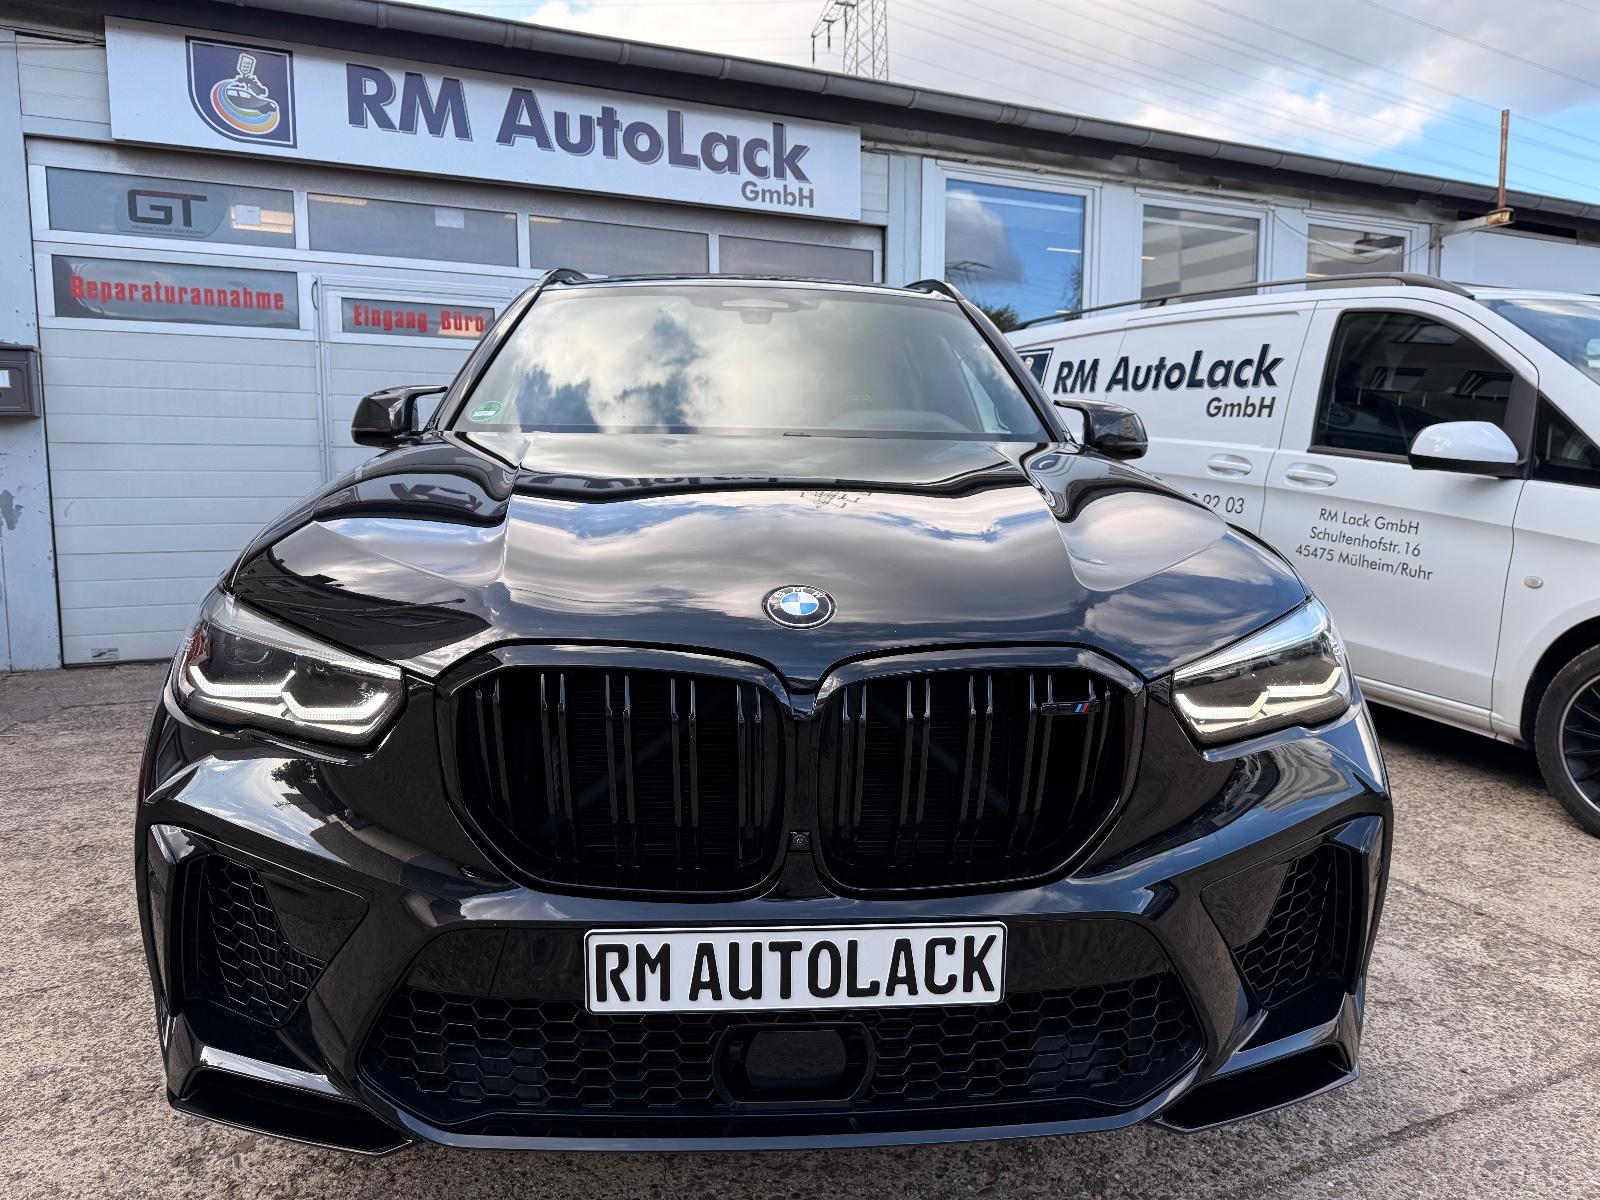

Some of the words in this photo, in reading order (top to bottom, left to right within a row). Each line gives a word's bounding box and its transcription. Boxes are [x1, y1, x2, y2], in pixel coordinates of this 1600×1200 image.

[346, 63, 473, 142] RM
[496, 87, 810, 184] AutoLack
[127, 189, 207, 227] GT
[741, 180, 815, 209] GmbH
[70, 274, 285, 311] Reparaturannahme
[353, 304, 427, 333] Eingang
[440, 309, 485, 333] Büro
[1053, 358, 1100, 394] RM
[1105, 343, 1284, 393] AutoLack
[1206, 395, 1276, 418] GmbH
[1225, 496, 1245, 514] 03
[1318, 508, 1339, 522] RM
[1342, 511, 1371, 528] Lack
[1374, 516, 1420, 535] GmbH
[1310, 526, 1400, 554] Schultenhofstr.
[1404, 542, 1421, 557] 16
[1295, 544, 1334, 562] 45475
[1337, 551, 1434, 580] Mülheim/Ruhr
[594, 942, 671, 1002] RM
[688, 934, 998, 1001] AUTOLACK
